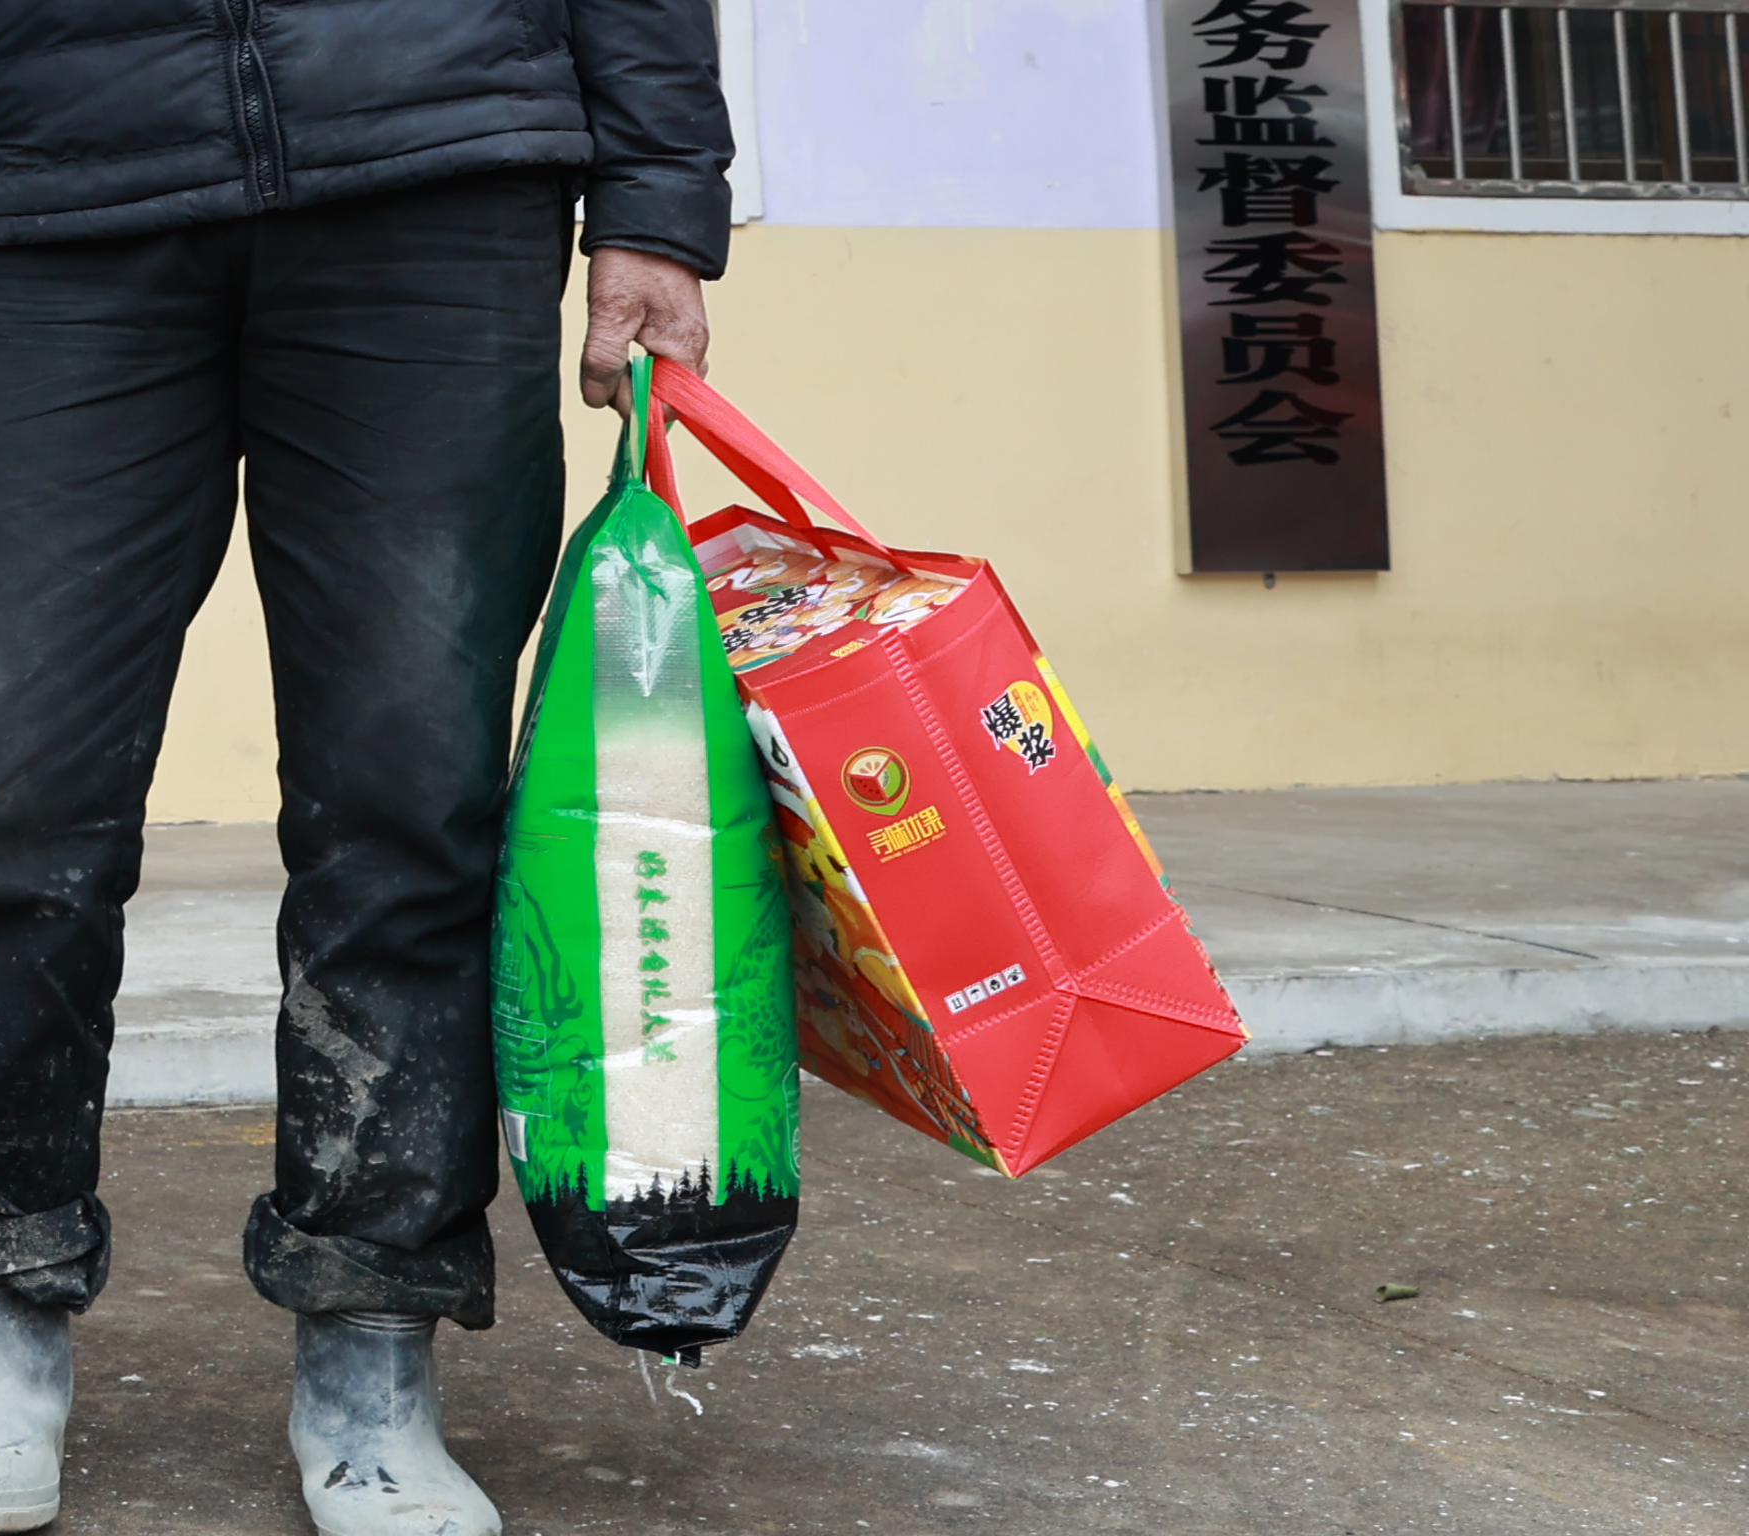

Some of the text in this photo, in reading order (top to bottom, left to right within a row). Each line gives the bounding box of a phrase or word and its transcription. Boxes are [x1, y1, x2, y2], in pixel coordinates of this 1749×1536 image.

[983, 691, 1055, 770] 爆浆
[866, 805, 946, 856] 寻味优果
